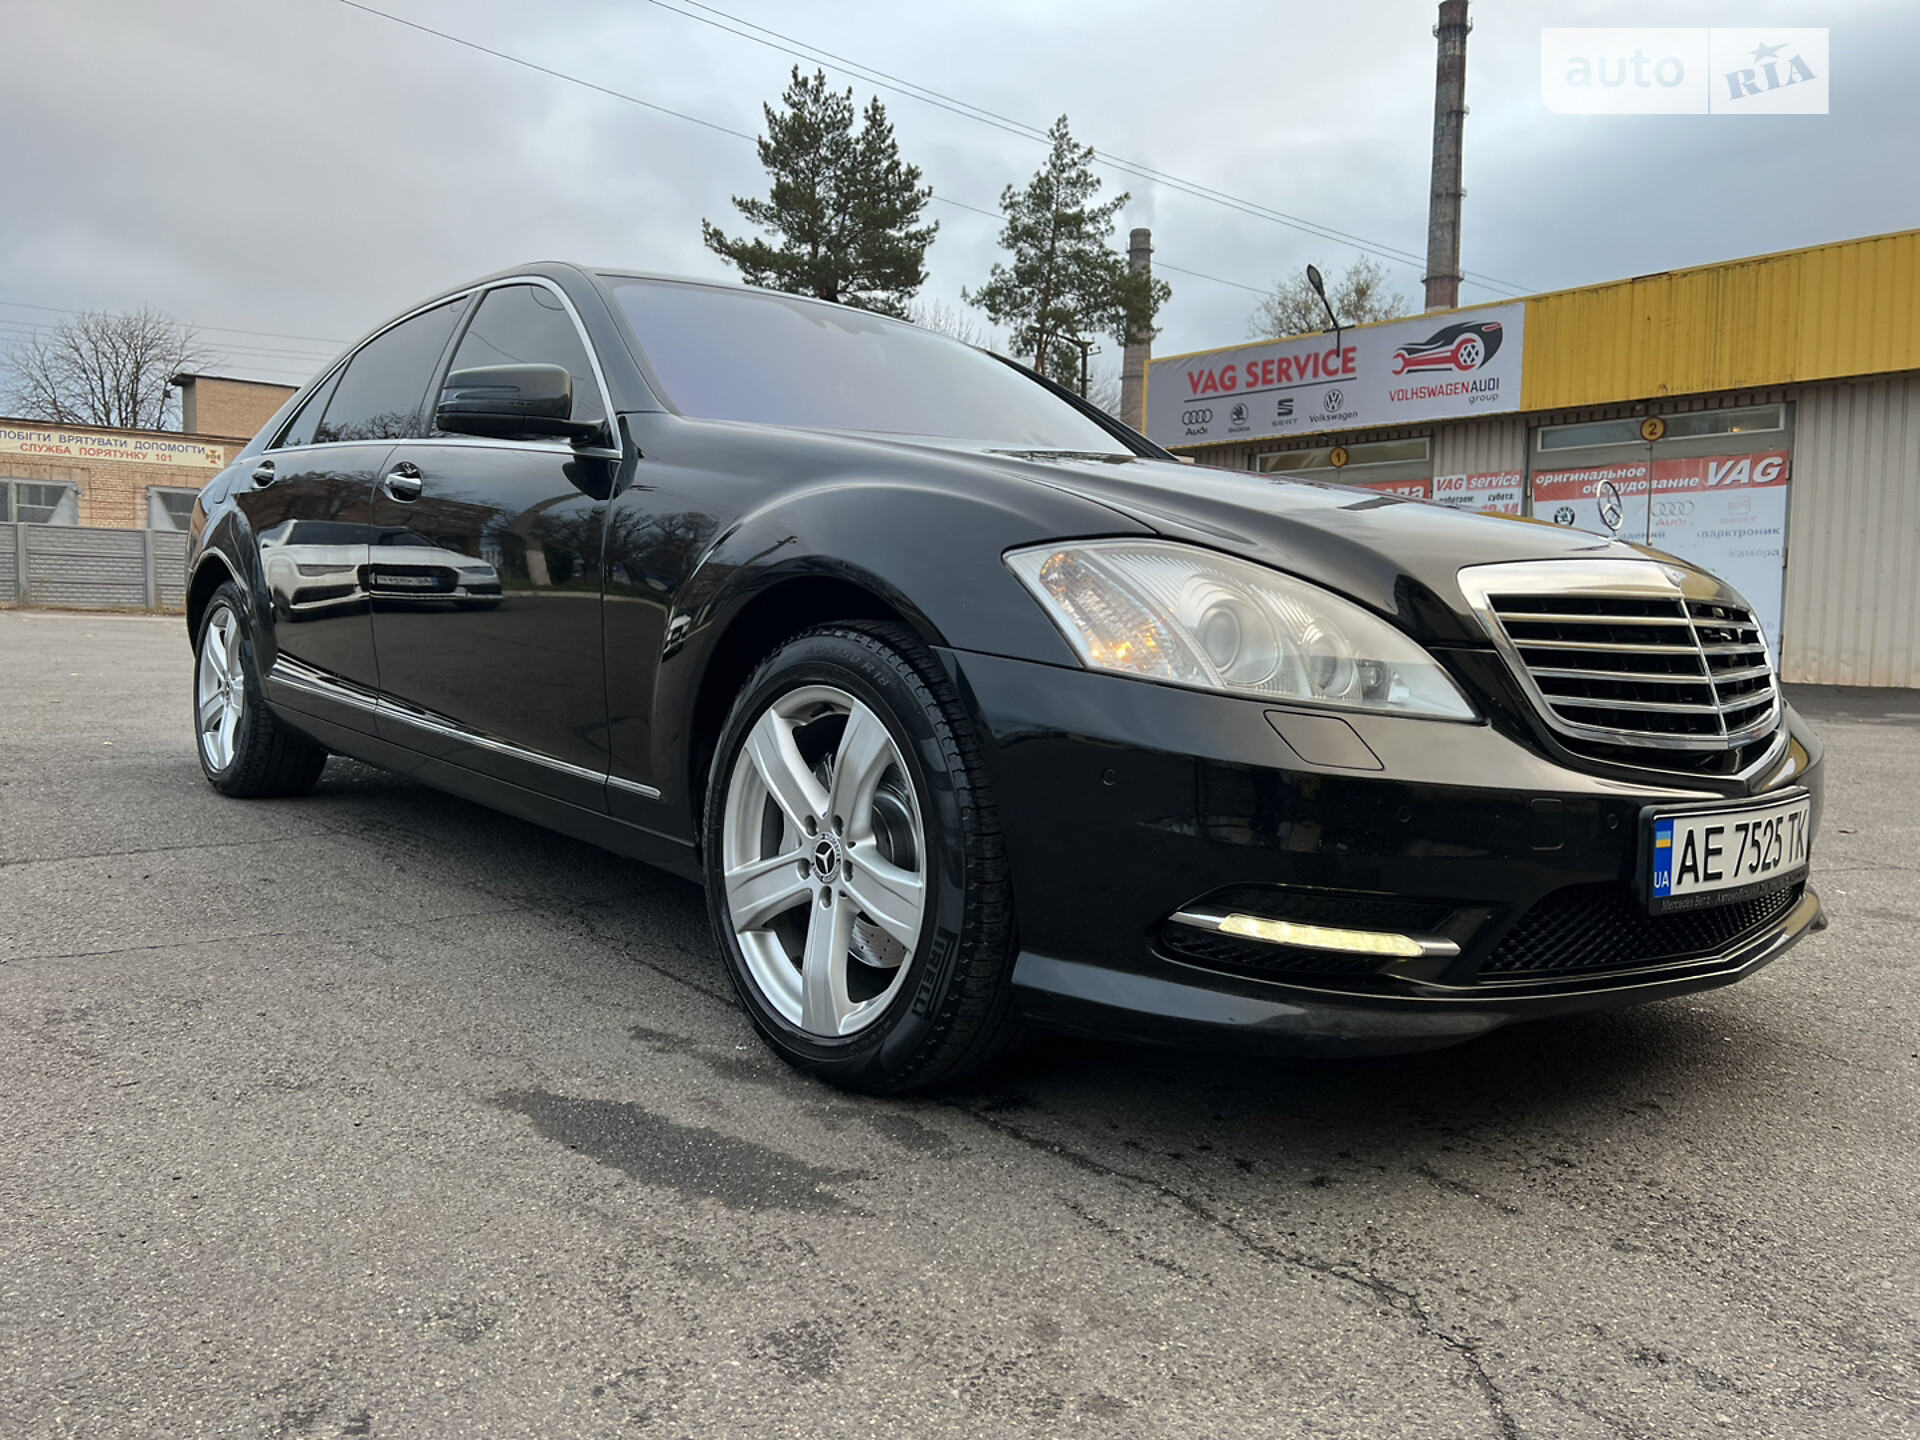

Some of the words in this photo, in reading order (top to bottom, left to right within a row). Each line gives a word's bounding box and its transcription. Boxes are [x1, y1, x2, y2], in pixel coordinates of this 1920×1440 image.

[1187, 365, 1237, 396] VAG
[1245, 346, 1357, 388] SERVICE
[1469, 392, 1499, 405] group
[1271, 418, 1299, 427] SEAT
[1308, 411, 1358, 423] Volkswagen
[1185, 427, 1208, 436] Audi
[1648, 423, 1657, 435] 2
[59, 435, 128, 448] ВРЯТУВАТИ
[134, 440, 205, 454] ДОПОМОГТИ
[20, 443, 72, 455] СЛУЖБА
[79, 447, 147, 460] ПОРЯТУНКУ
[155, 454, 172, 462] 101
[1535, 467, 1646, 486] оригинальное
[1705, 456, 1783, 487] VAG
[1437, 478, 1464, 491] VAG
[1469, 473, 1520, 488] service
[1701, 527, 1780, 539] парктроник
[1729, 549, 1780, 559] камера
[1654, 870, 1670, 889] UA
[1676, 826, 1725, 885] AE
[1733, 816, 1783, 878] 7525
[1788, 808, 1807, 863] TK
